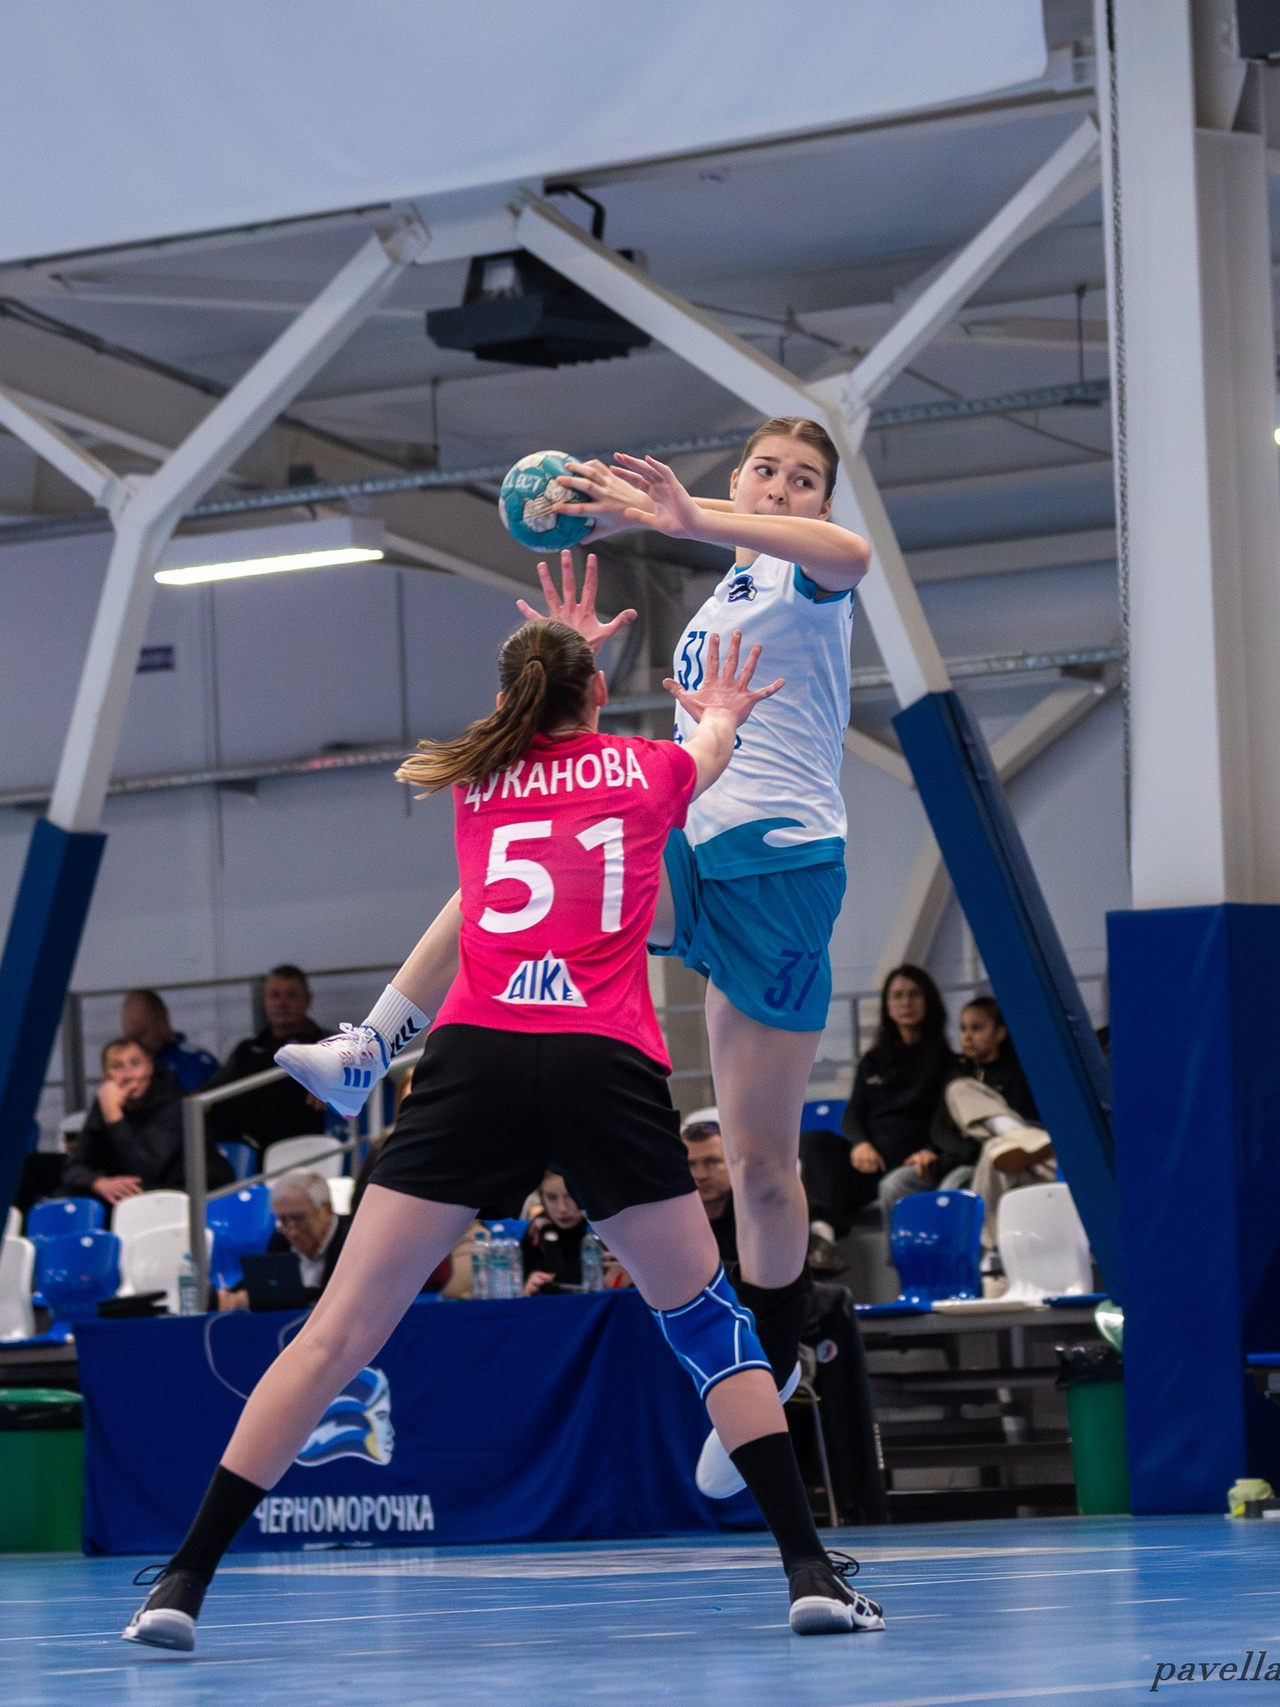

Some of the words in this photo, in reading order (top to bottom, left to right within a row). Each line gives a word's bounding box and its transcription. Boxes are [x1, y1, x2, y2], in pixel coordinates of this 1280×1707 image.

[477, 817, 625, 934] 51
[764, 948, 822, 1011] 37
[253, 1494, 435, 1534] ЧЕРНОМОРОЧКА
